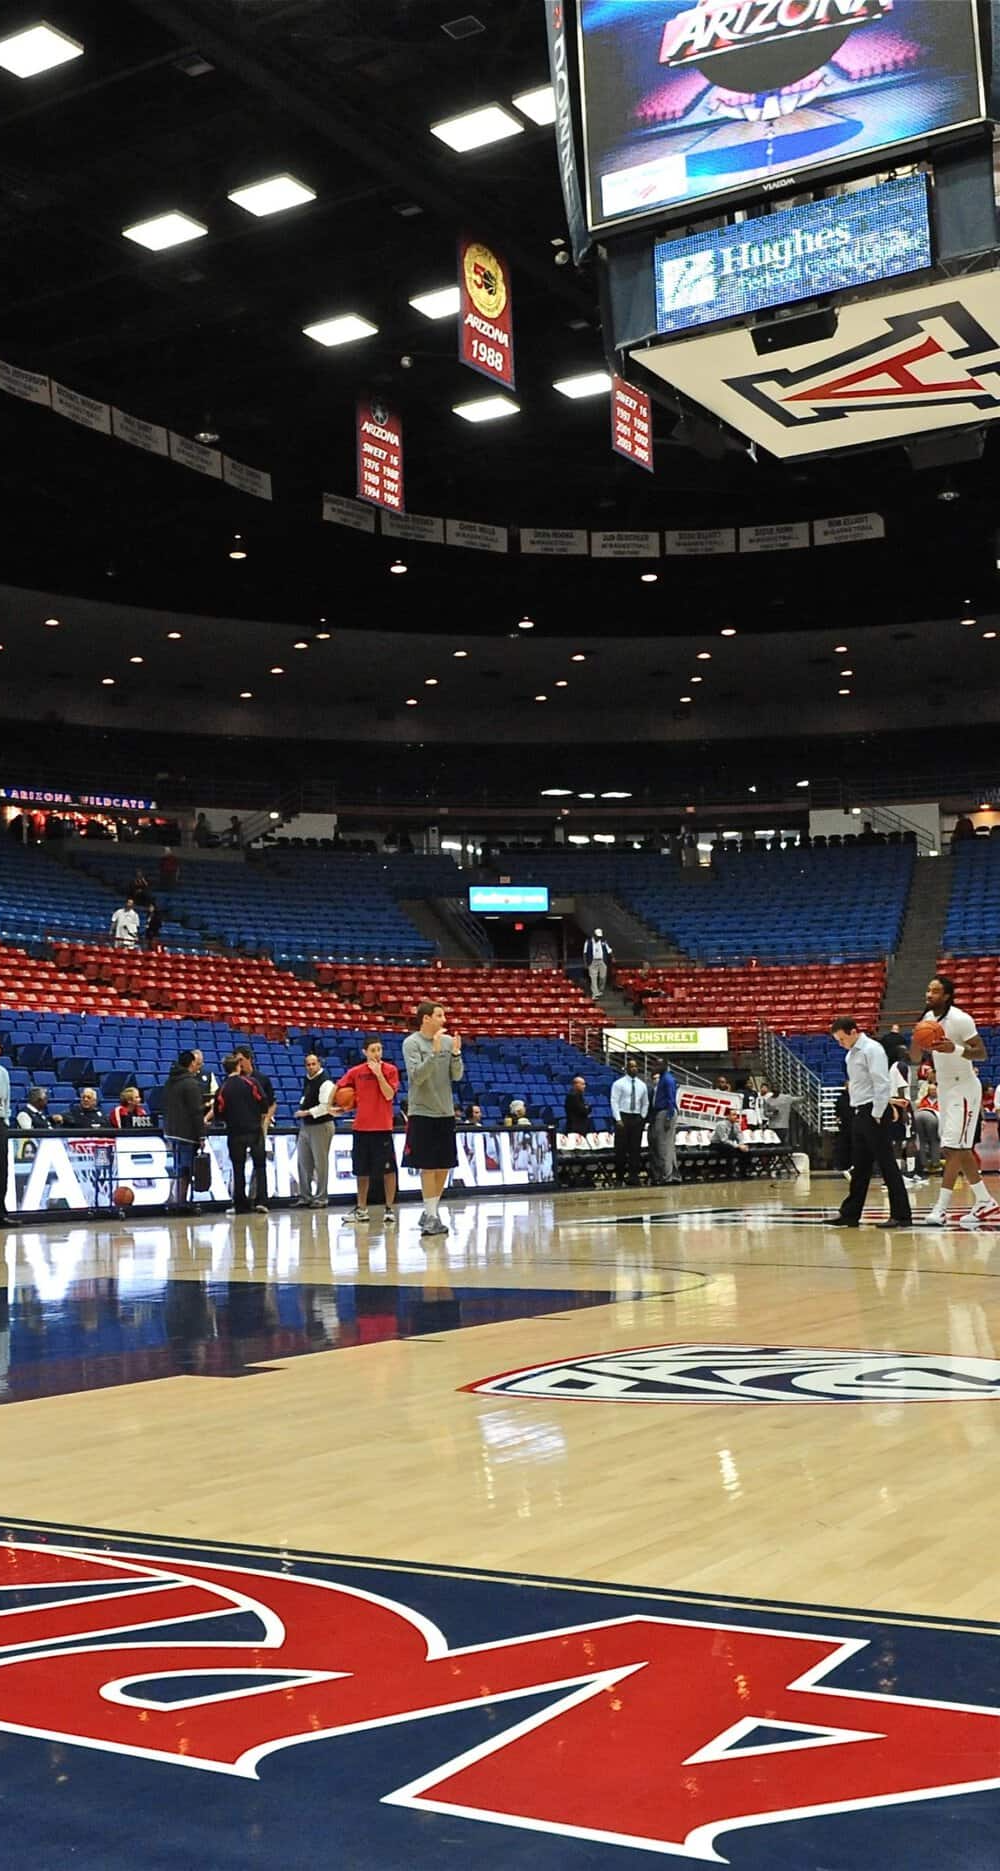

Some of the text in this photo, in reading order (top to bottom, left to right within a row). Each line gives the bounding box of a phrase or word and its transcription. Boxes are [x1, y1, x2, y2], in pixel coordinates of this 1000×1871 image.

[719, 221, 852, 275] Hughes
[464, 312, 509, 348] ARIZONA
[471, 339, 503, 372] 1988
[361, 420, 400, 447] ARIZONA
[362, 442, 399, 467] SWEET 16
[11, 789, 145, 809] ARIZONA WILDCATS
[629, 1031, 697, 1043] SUNSTREET
